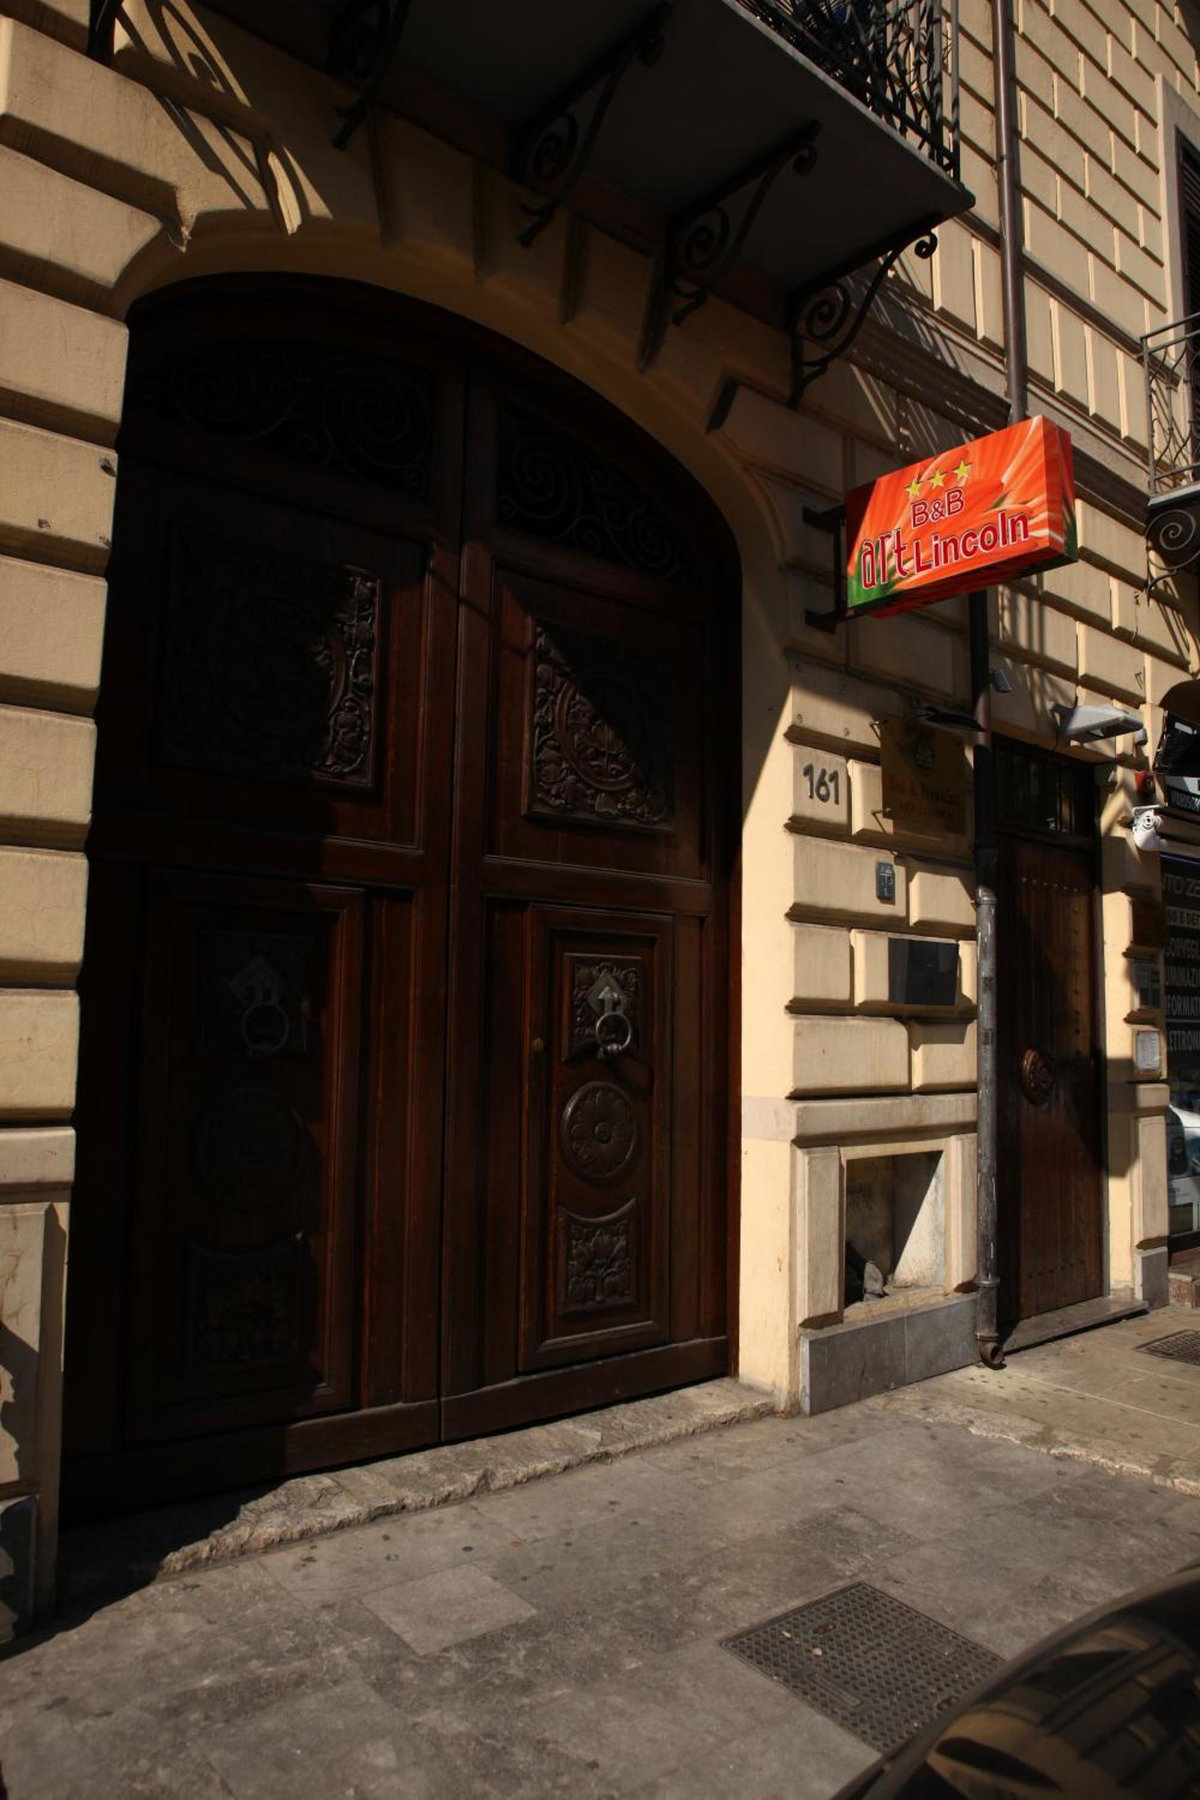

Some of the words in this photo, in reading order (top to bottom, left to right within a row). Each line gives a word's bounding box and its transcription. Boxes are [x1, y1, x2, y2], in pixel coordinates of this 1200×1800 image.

[911, 488, 965, 527] B&B
[861, 530, 909, 590] art
[912, 510, 1031, 576] Lincoln
[803, 763, 840, 805] 161
